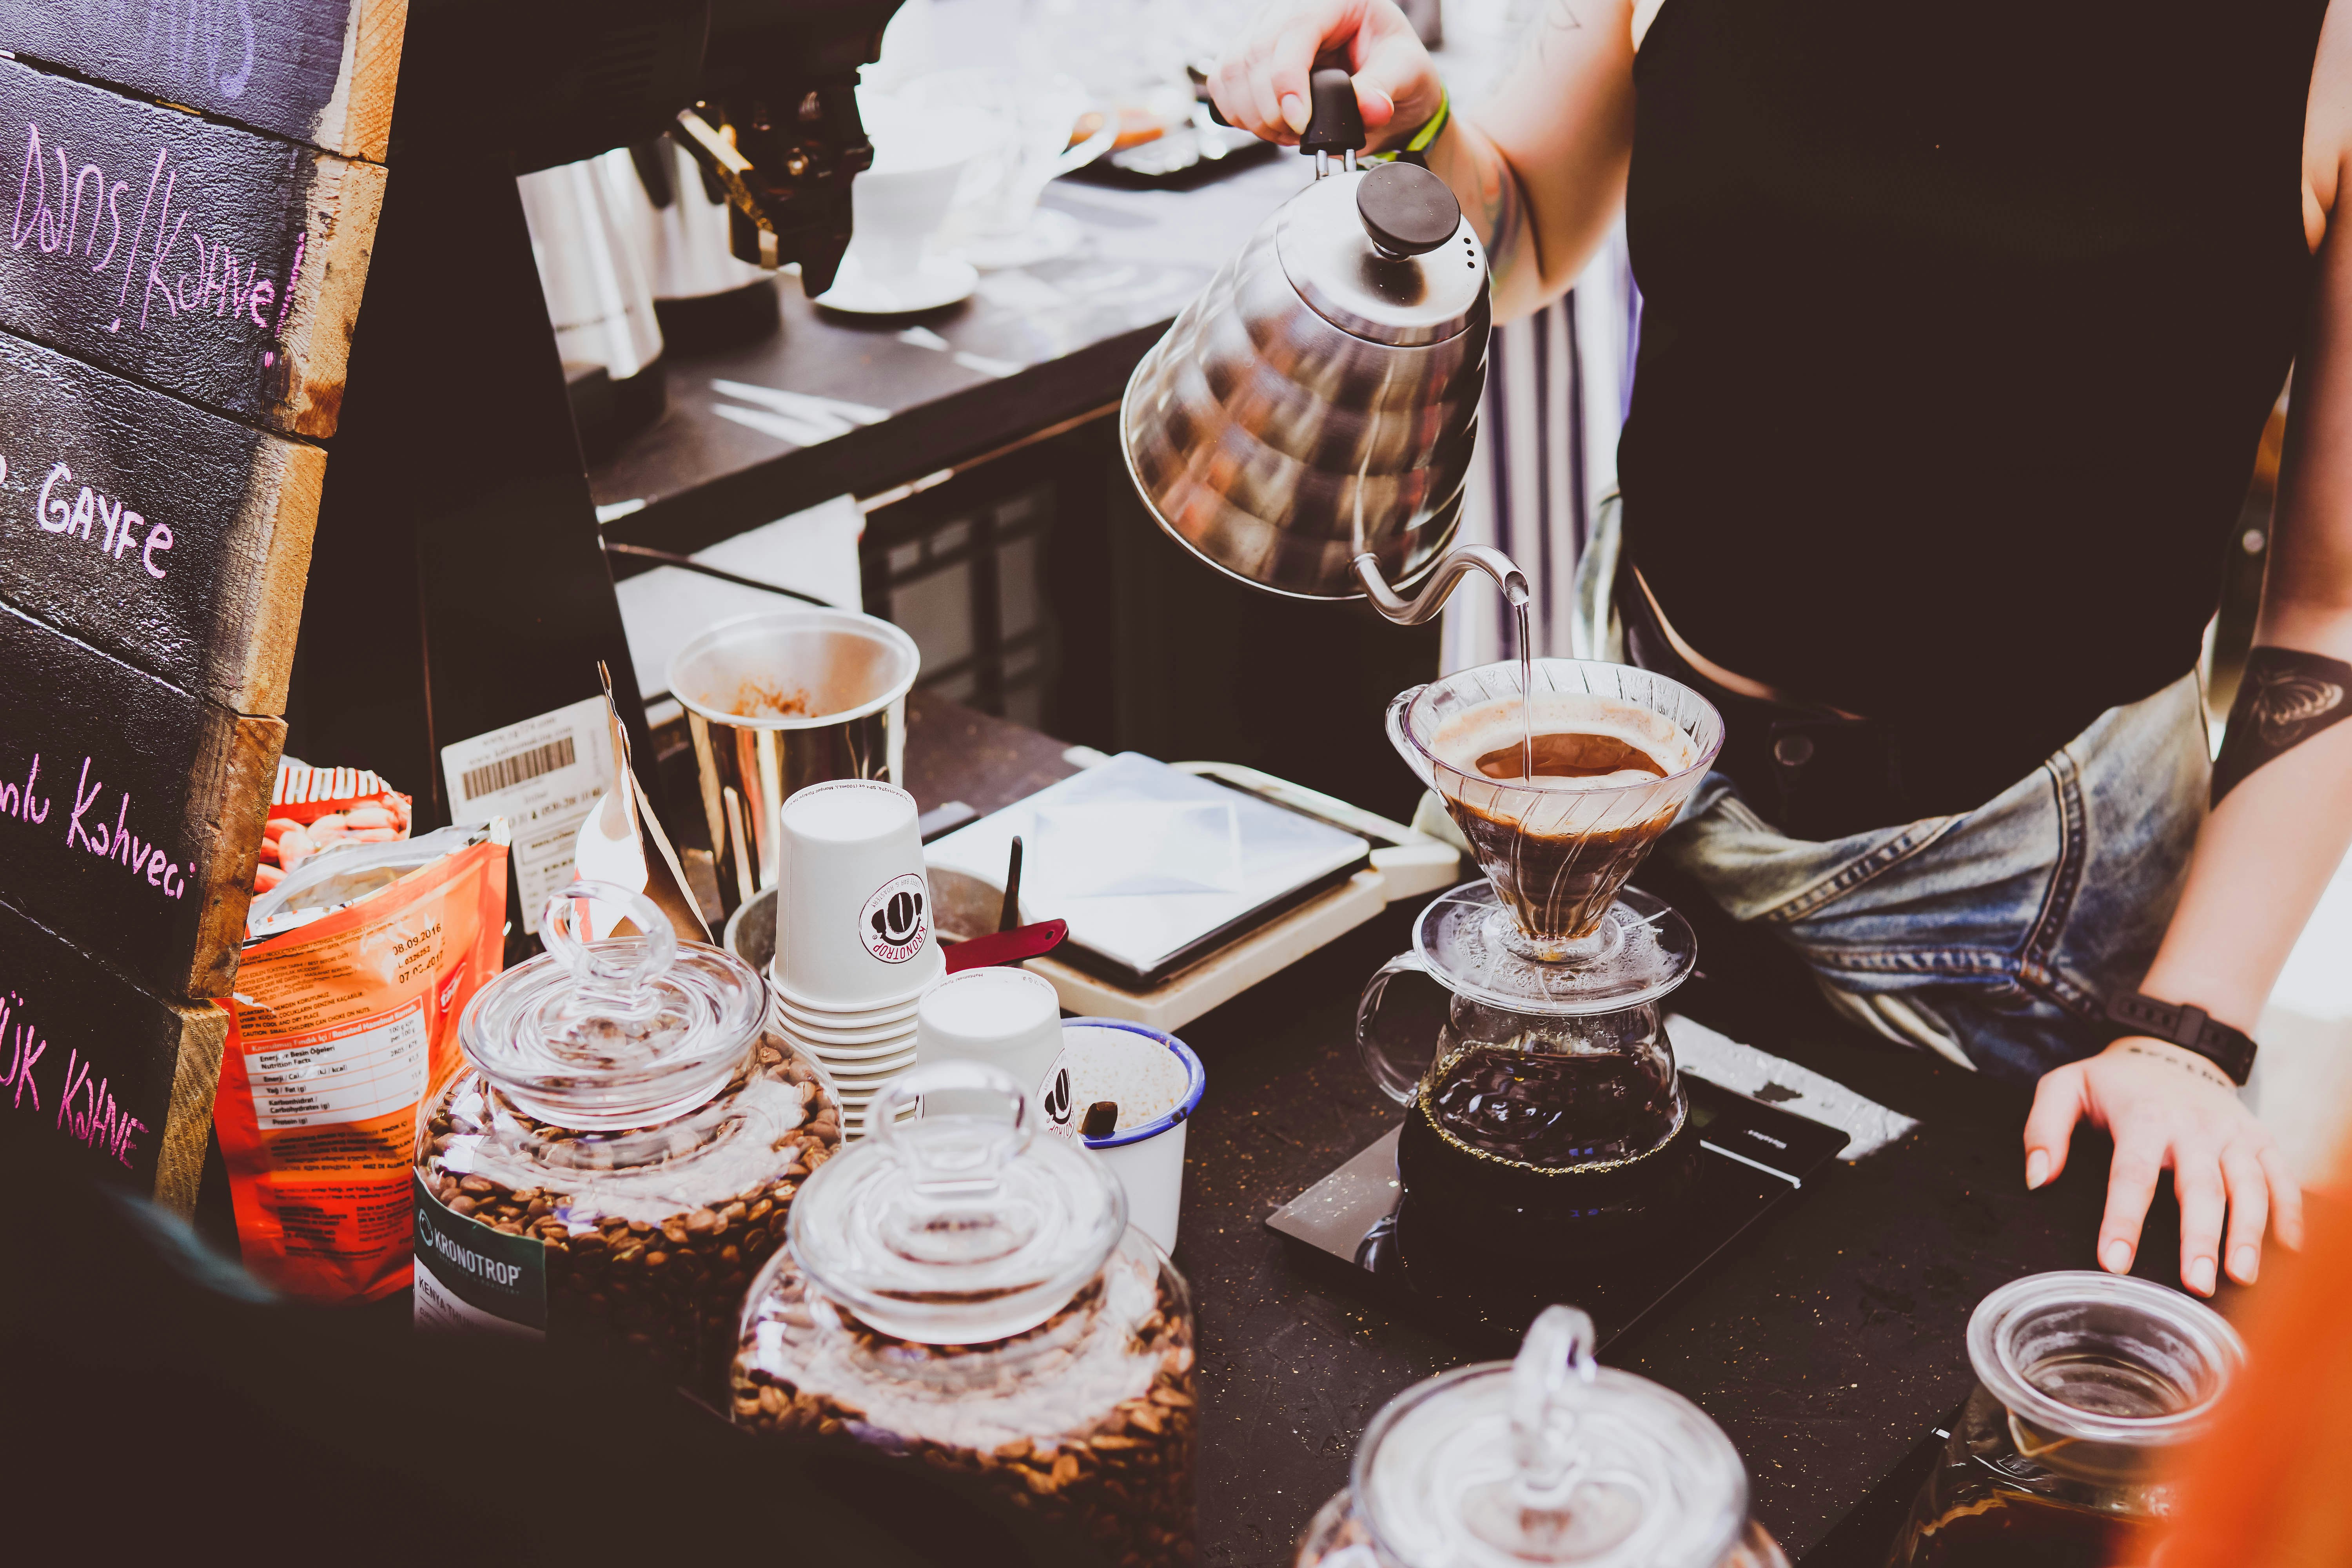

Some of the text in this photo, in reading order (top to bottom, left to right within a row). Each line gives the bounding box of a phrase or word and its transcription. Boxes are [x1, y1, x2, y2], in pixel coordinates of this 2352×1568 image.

[871, 885, 894, 908] ROASTERY
[873, 926, 926, 960] KRONOTROP
[289, 1022, 314, 1032] CHILDREN
[435, 1227, 519, 1286] KRONOTROP
